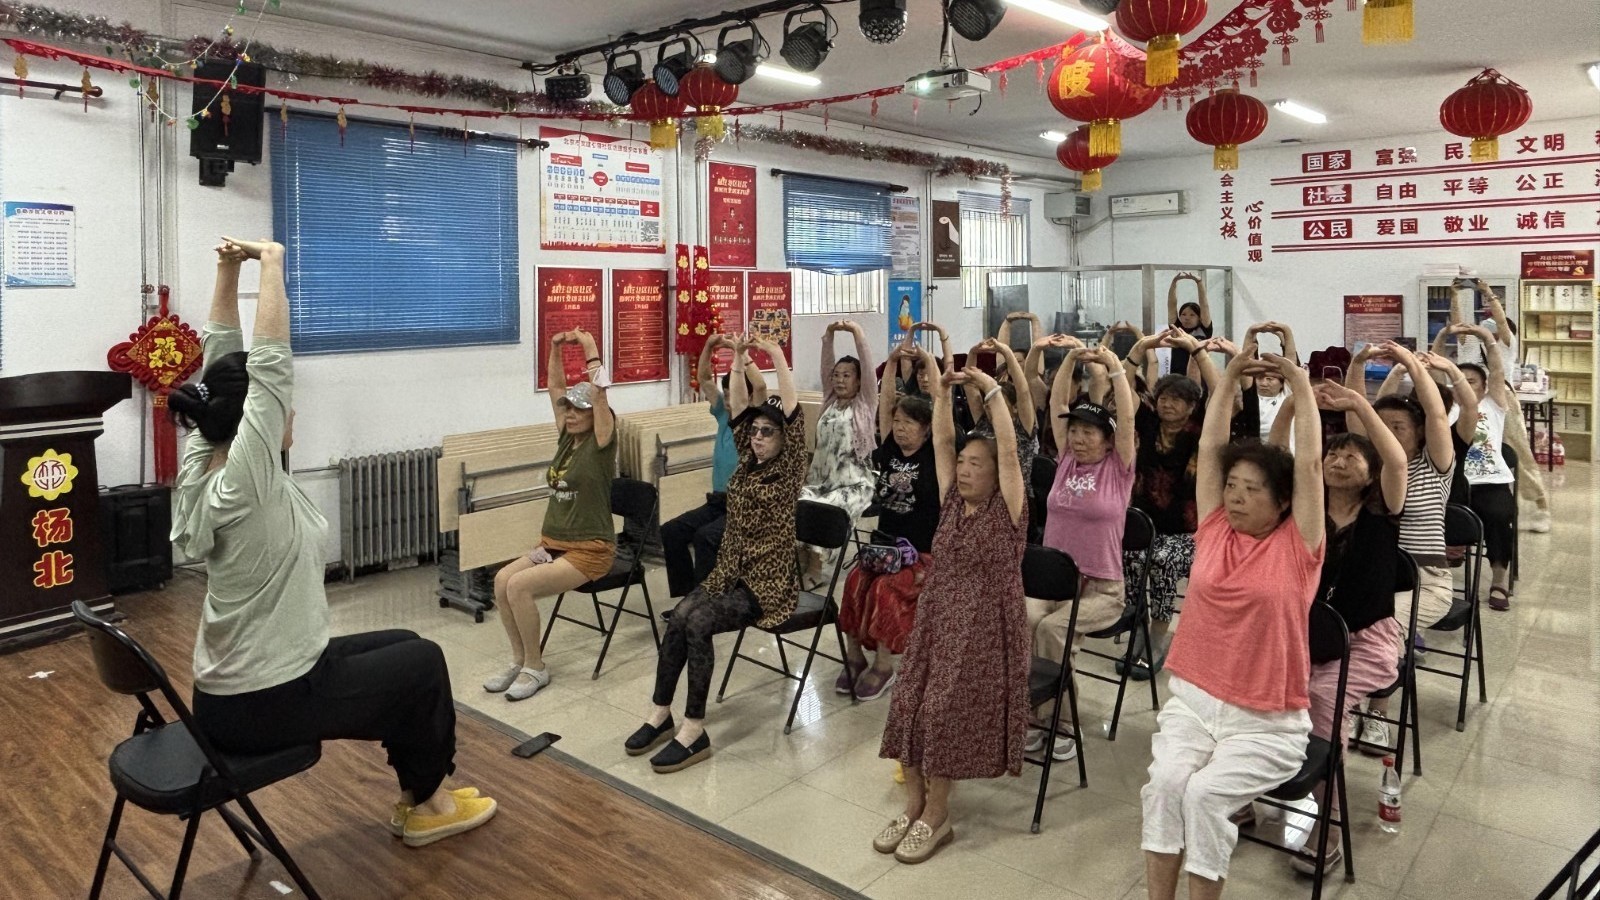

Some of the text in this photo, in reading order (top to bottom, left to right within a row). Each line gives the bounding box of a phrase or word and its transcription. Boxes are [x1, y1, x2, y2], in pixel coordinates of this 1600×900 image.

[1059, 59, 1096, 100] 度
[1307, 152, 1346, 171] 国家
[1376, 147, 1417, 166] 富强
[1516, 133, 1565, 154] 文明
[1307, 172, 1564, 204] 社会 自由 平等 公正
[1245, 200, 1264, 263] 心价值观
[1308, 210, 1566, 238] 公民 爱国 敬业 诚信
[31, 507, 74, 589] 杨北
